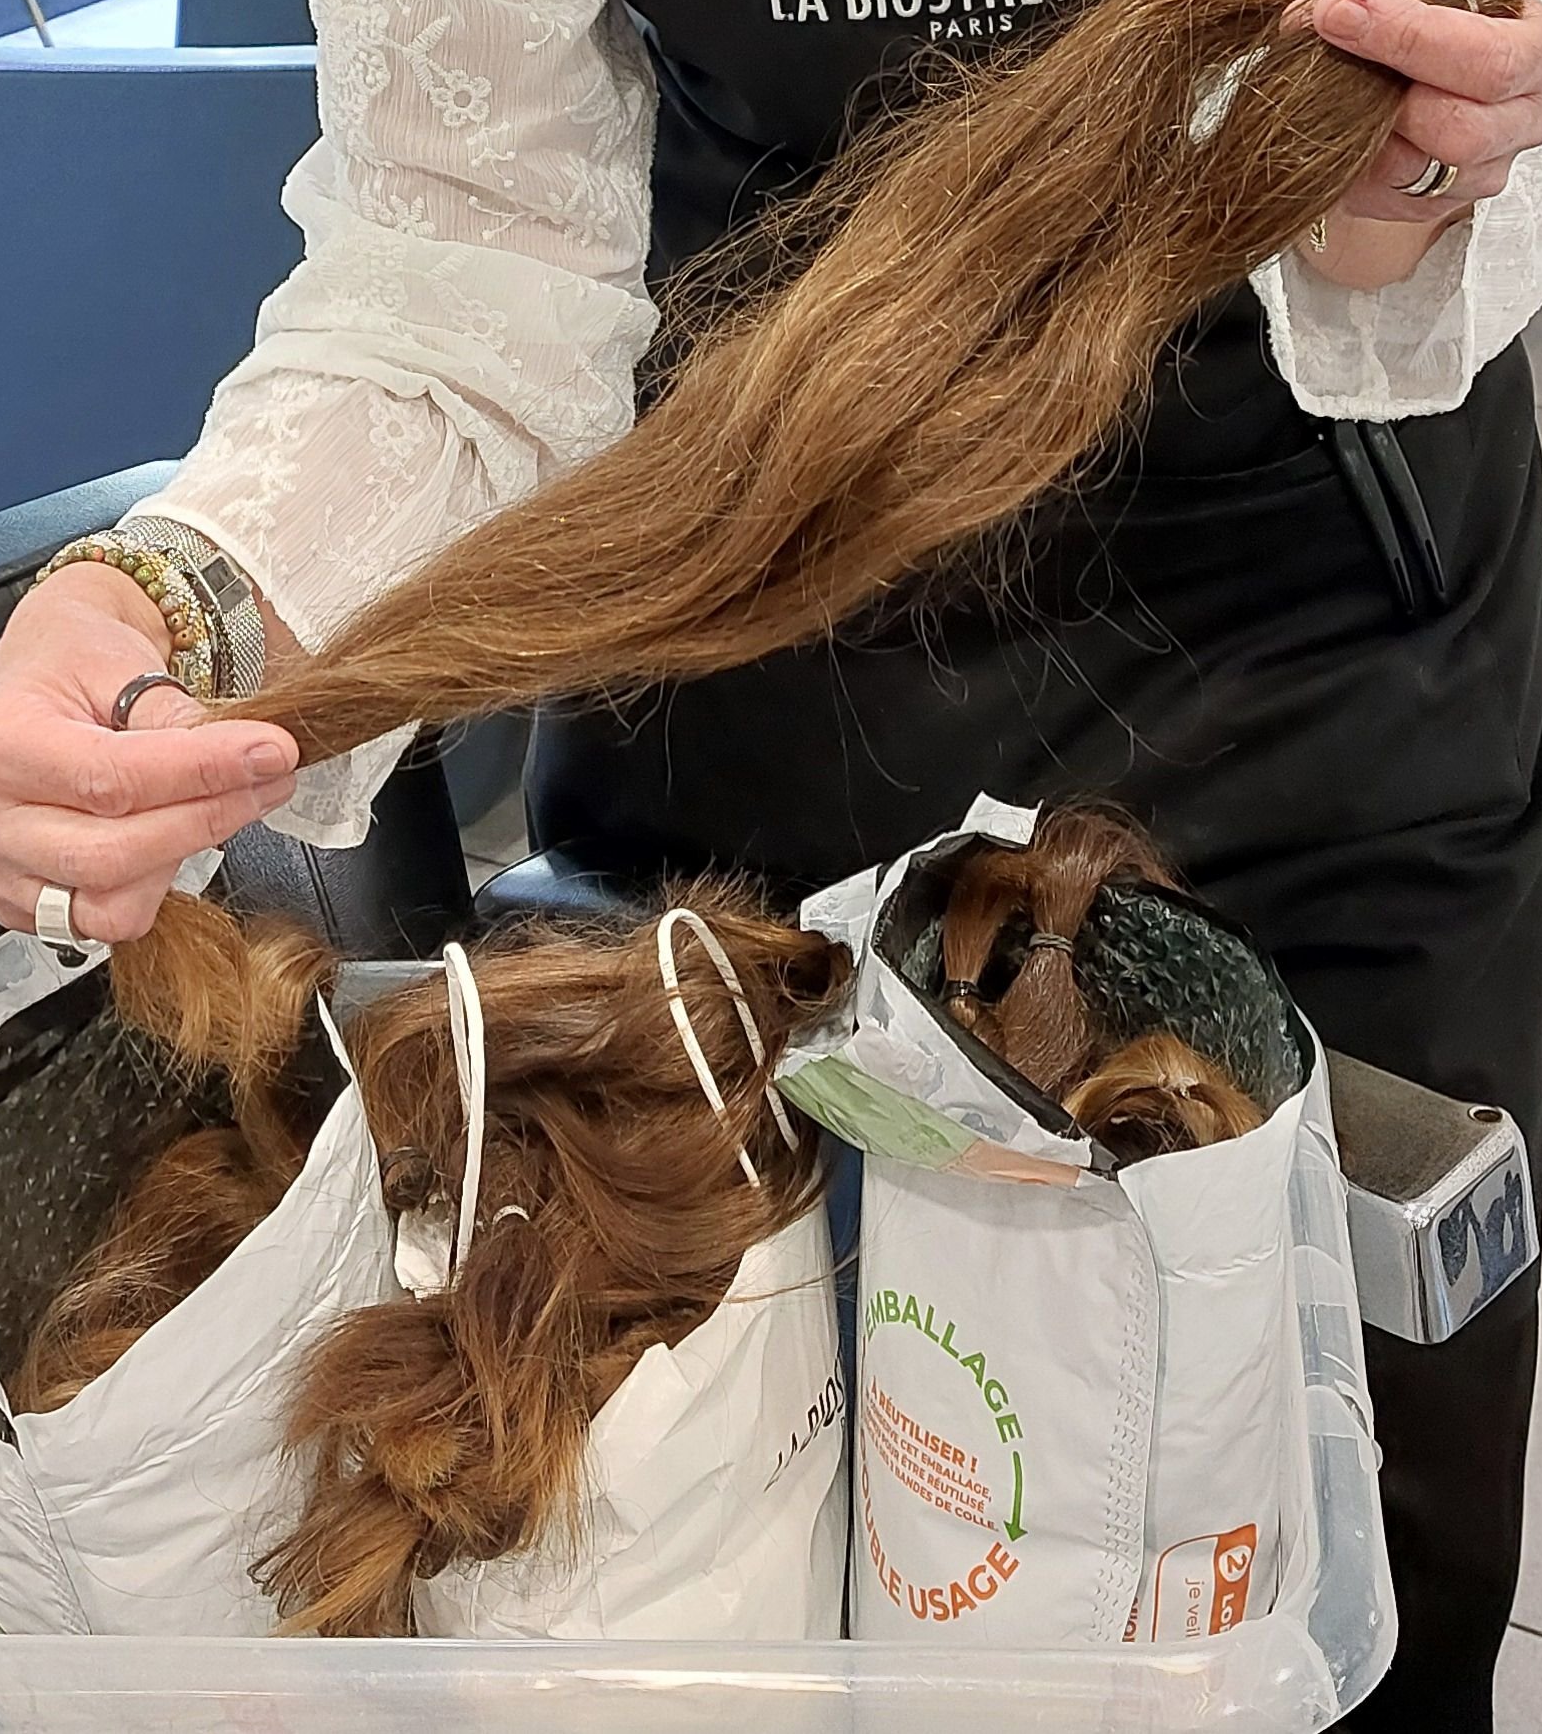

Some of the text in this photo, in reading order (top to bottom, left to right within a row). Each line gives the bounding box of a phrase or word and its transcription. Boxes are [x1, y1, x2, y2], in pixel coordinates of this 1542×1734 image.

[929, 12, 1013, 41] PARIS
[864, 1290, 1023, 1443] EMBALLAGE
[878, 1388, 966, 1468] RÉUTILISER
[895, 1467, 934, 1503] BANDES
[935, 1495, 952, 1514] DE
[900, 1438, 919, 1458] CET
[921, 1452, 992, 1503] EMBALLAGE,
[901, 1453, 926, 1480] ÊTRE
[927, 1473, 985, 1514] RÉUTILISÉ
[908, 1541, 1020, 1622] USAGE
[1185, 1577, 1205, 1599] je
[1226, 1552, 1248, 1574] 2
